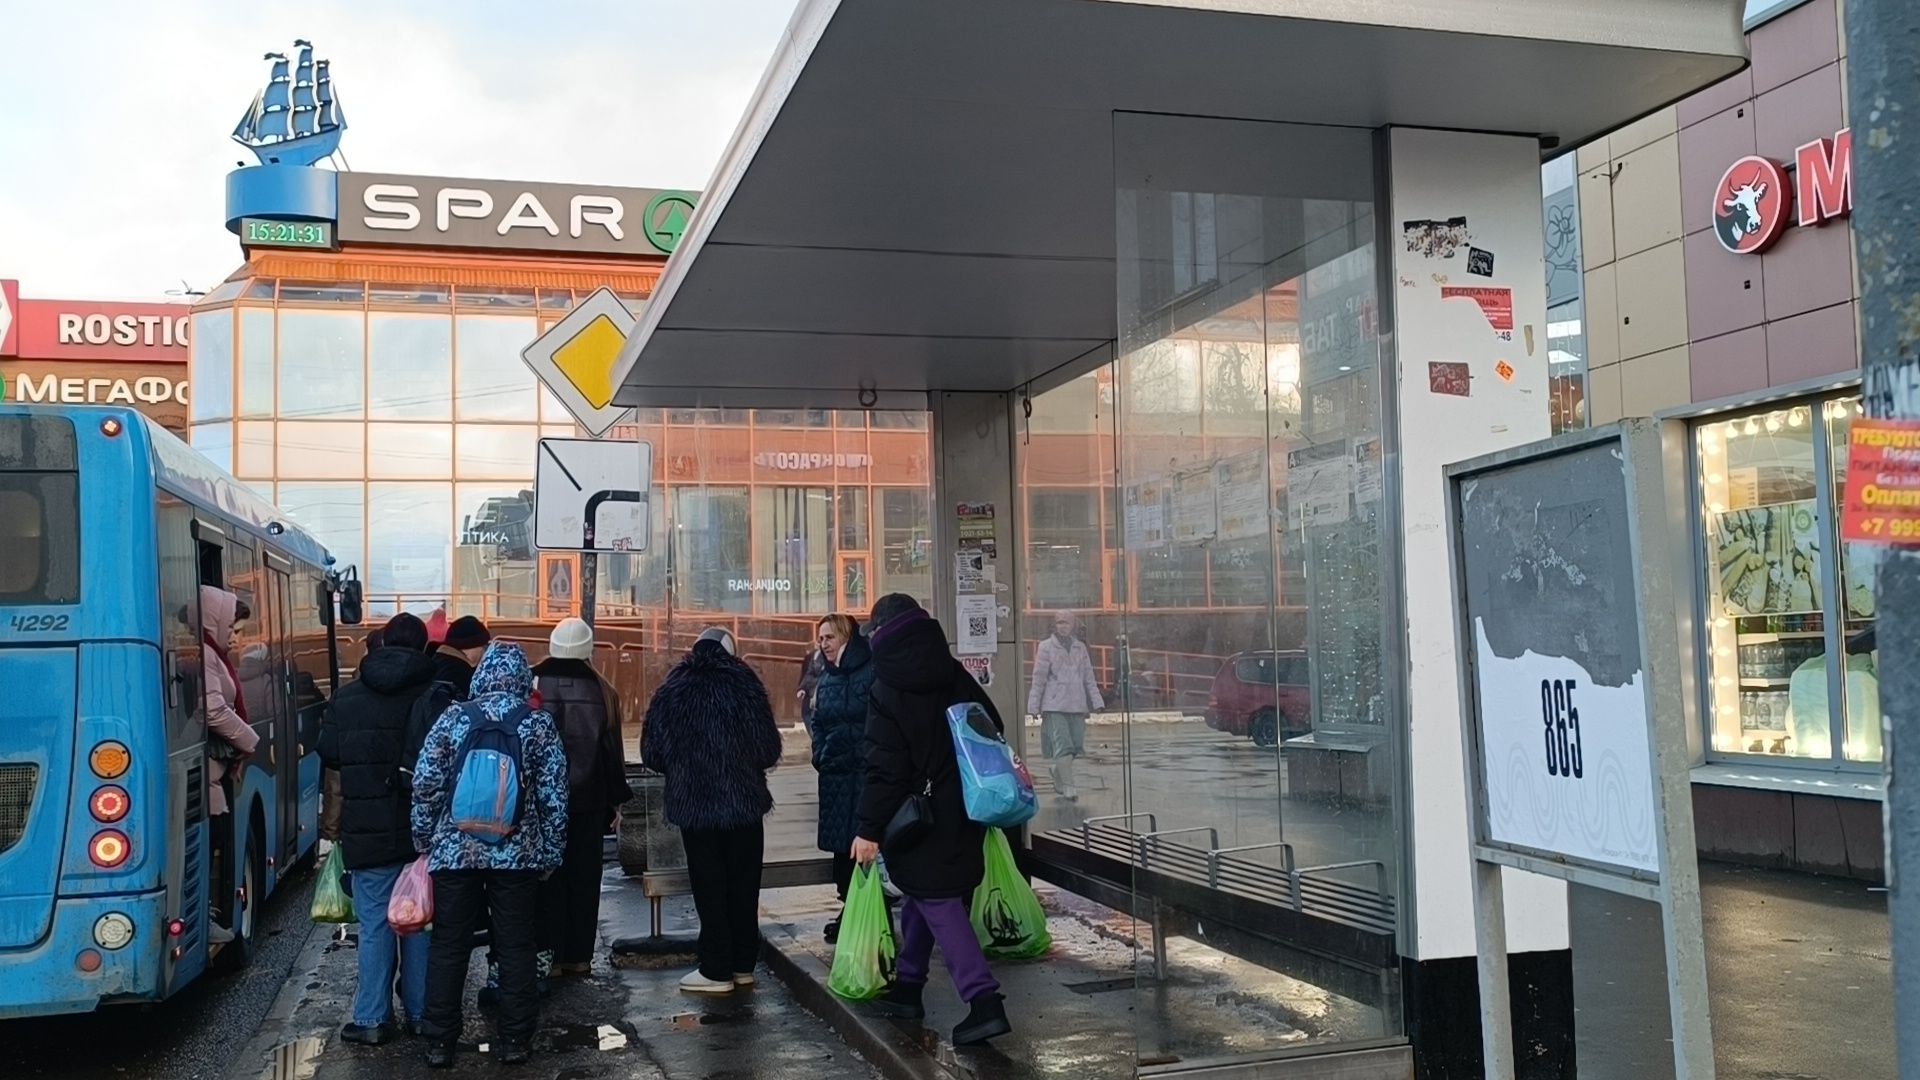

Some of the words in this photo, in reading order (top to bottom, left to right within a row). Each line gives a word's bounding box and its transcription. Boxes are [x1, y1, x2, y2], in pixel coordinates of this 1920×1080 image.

[363, 184, 625, 241] SPAR
[248, 222, 325, 244] 15:21:31
[1860, 517, 1885, 536] +7
[10, 614, 70, 632] 4292
[1541, 679, 1583, 779] 865
